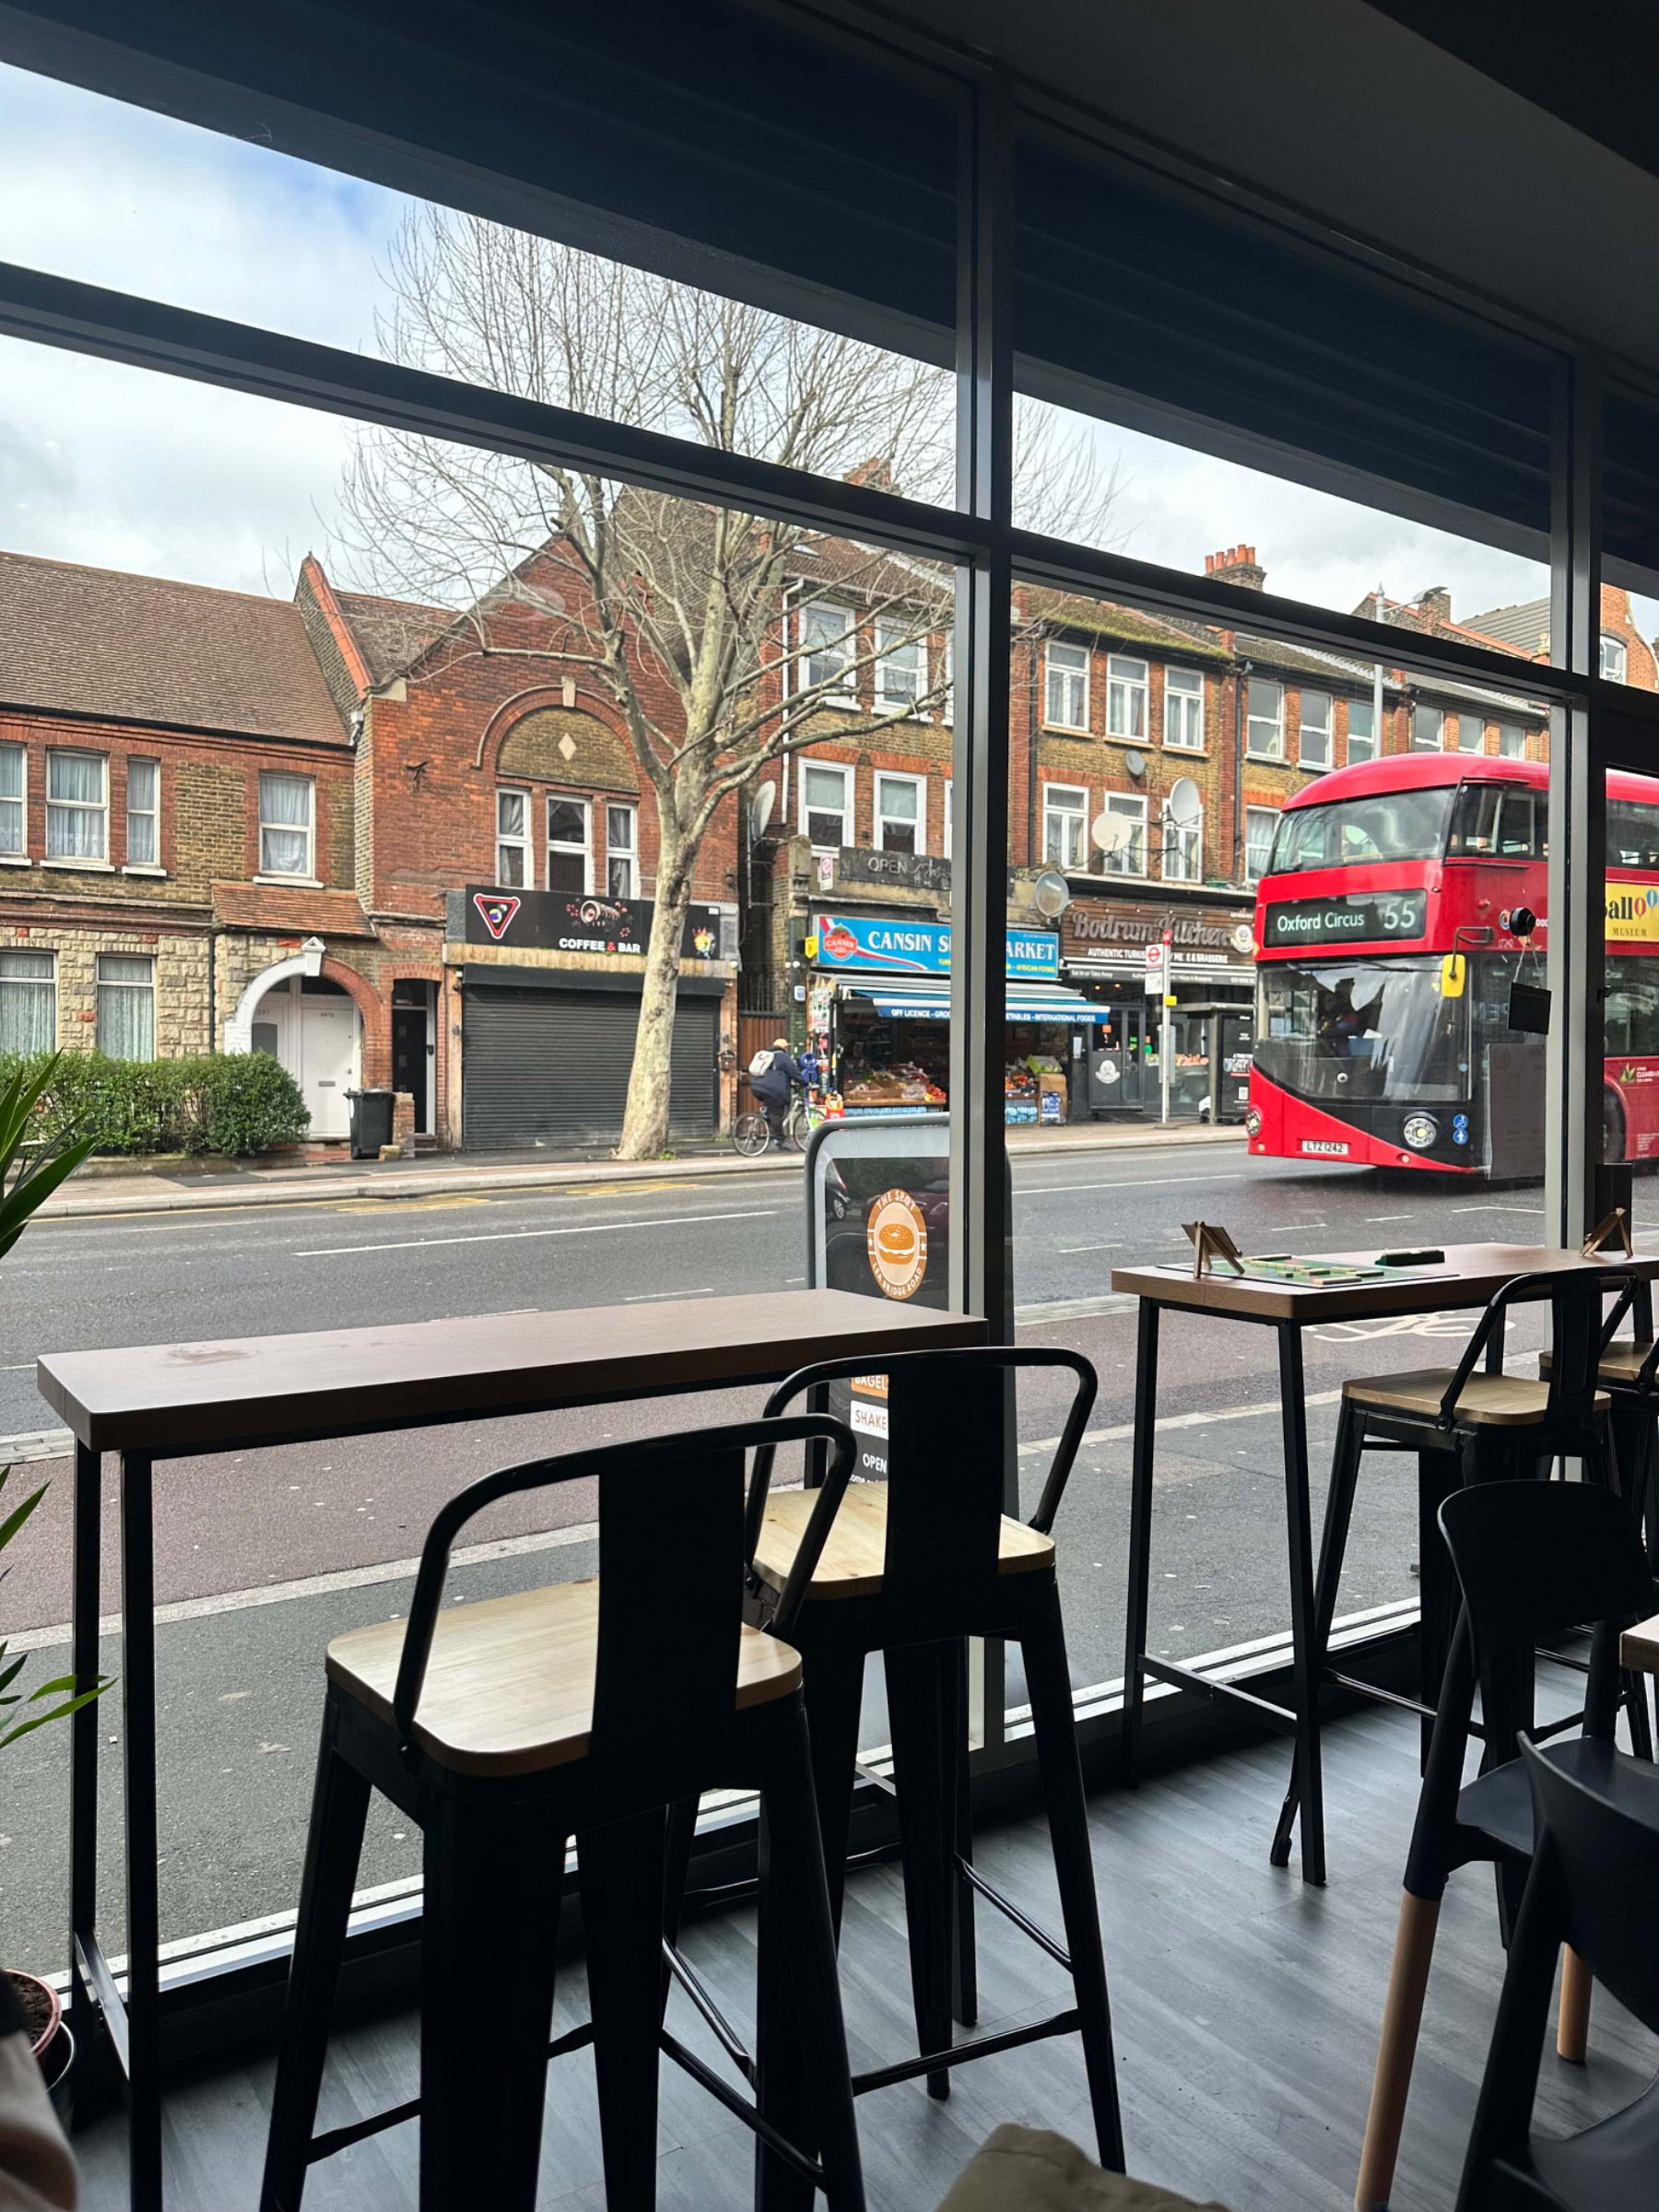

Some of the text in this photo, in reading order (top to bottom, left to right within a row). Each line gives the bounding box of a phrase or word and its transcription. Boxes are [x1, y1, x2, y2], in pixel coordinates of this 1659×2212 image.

[868, 857, 907, 874] OPEN
[1277, 912, 1365, 933] Oxford Circus
[1383, 900, 1417, 930] 55
[1072, 912, 1153, 939] Bodrum
[1613, 927, 1647, 937] MUSEUM
[559, 937, 641, 953] COFFEE & BAR
[867, 931, 932, 951] CANSIN
[1088, 947, 1124, 958] AUTHENTIC
[1124, 949, 1146, 959] TURKIS
[1197, 953, 1229, 964] BRASSERIE
[891, 1008, 904, 1017] OFF
[904, 1009, 930, 1018] LICENCE
[935, 1010, 951, 1018] GROC
[1006, 1013, 1030, 1021] ETABLES
[1035, 1015, 1076, 1023] INTERNATIONAL
[1077, 1016, 1096, 1024] FOODS
[876, 1190, 916, 1211] THE SPOT
[882, 1279, 906, 1295] BRIDGE
[907, 1266, 923, 1292] ROAD
[863, 1453, 888, 1474] OPEN
